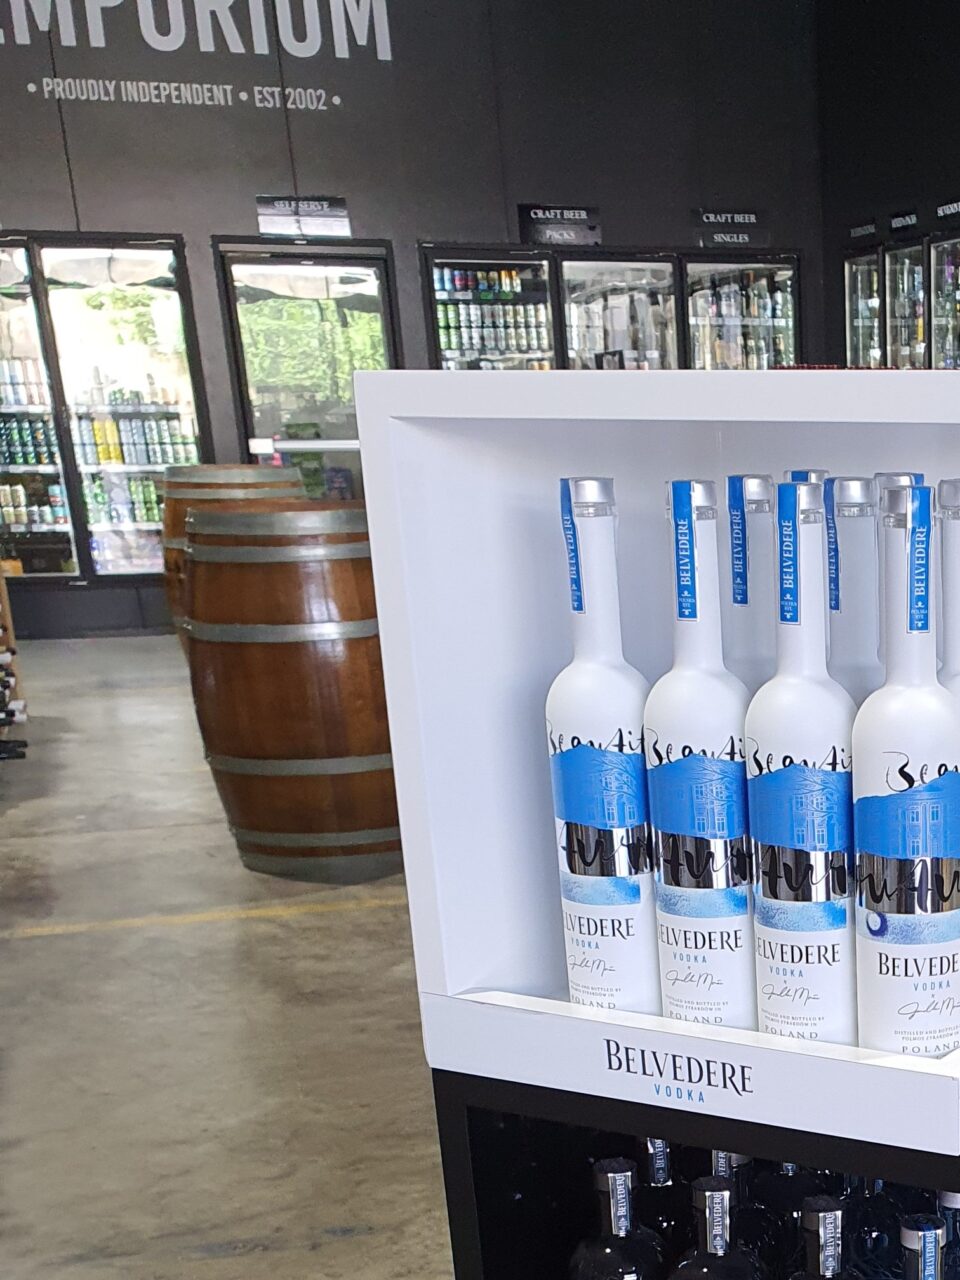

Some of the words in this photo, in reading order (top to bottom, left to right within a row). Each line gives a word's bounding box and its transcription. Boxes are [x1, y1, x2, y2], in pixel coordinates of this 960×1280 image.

[0, 0, 392, 60] MPORIUM
[43, 78, 116, 101] PROUDLY
[120, 81, 233, 106] INDEPENDENT
[254, 86, 282, 108] EST
[285, 88, 327, 110] 2002
[530, 209, 561, 219] CRAFT
[563, 210, 588, 220] BEER
[702, 214, 732, 223] CRAFT
[733, 214, 757, 224] BEER
[713, 233, 749, 244] SINGLES
[731, 508, 743, 573] BELVEDERE
[676, 517, 690, 585] BELVEDERE
[781, 518, 794, 588] BELVEDERE
[914, 525, 927, 596] BELVEDERE
[673, 951, 707, 964] VODKA
[769, 966, 804, 978] VODKA
[914, 979, 951, 992] VODKA
[669, 1010, 723, 1024] POLAND
[765, 1024, 818, 1039] POLAND
[902, 1040, 960, 1054] POLAND
[603, 1038, 754, 1097] BELVEDERE
[654, 1083, 705, 1103] VODKA
